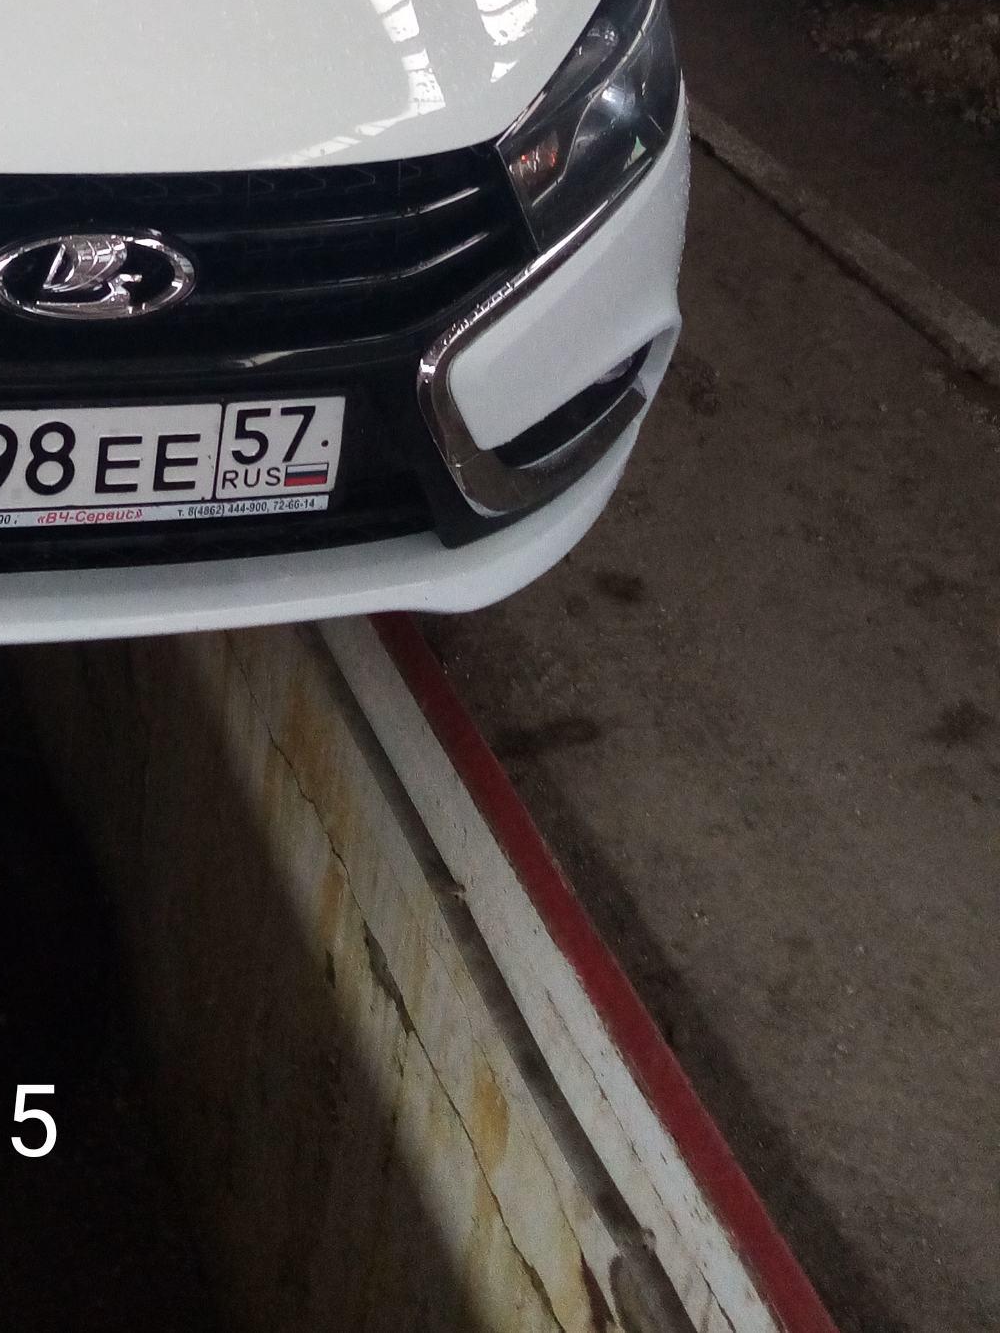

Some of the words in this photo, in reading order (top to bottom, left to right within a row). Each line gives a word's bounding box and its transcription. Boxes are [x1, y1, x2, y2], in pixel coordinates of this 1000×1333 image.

[230, 405, 317, 465] 57
[221, 467, 282, 490] RUS
[37, 509, 144, 525] «ВЧ-Сервис»
[188, 505, 225, 518] 8(4862)
[228, 501, 270, 514] 444-900,
[273, 498, 315, 511] 72-66-14
